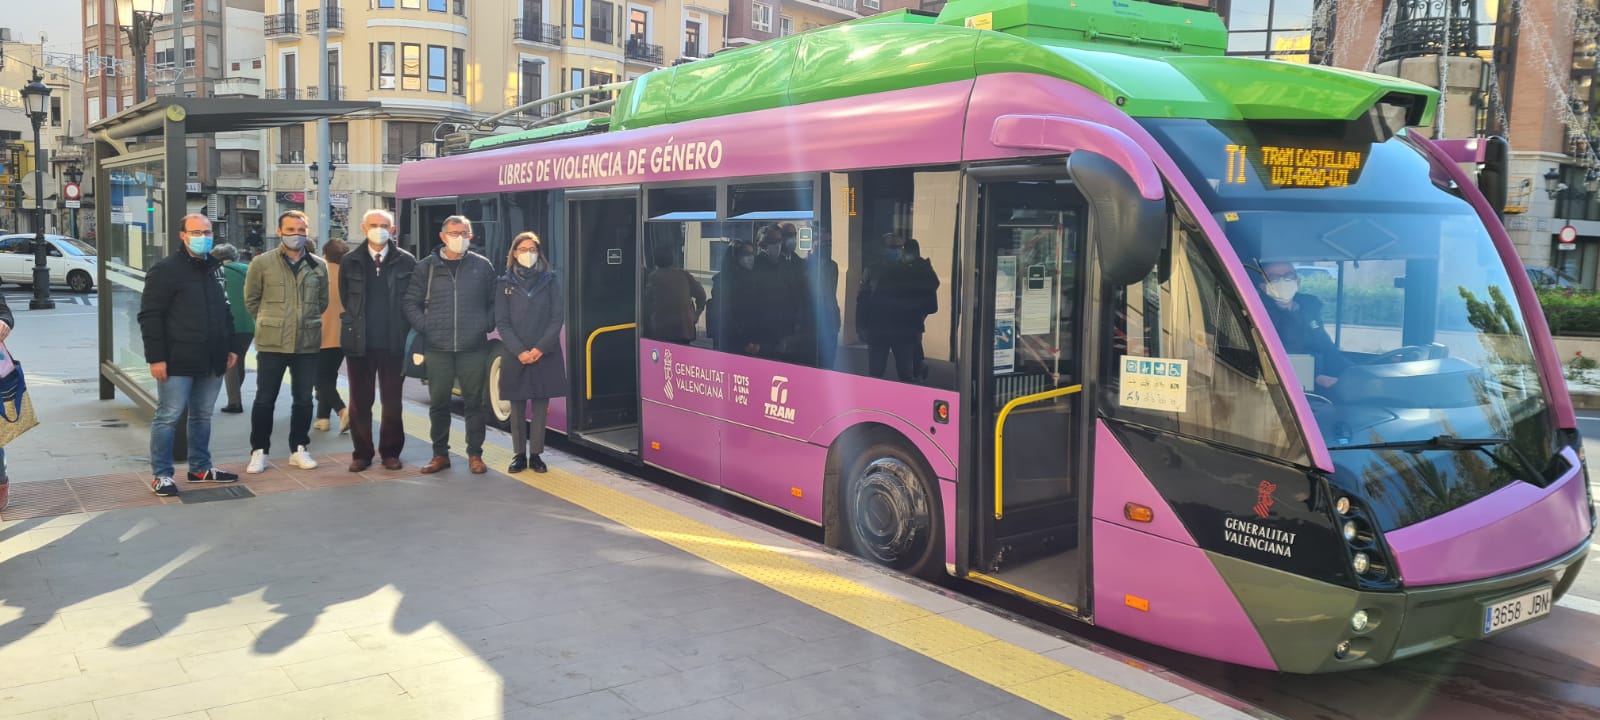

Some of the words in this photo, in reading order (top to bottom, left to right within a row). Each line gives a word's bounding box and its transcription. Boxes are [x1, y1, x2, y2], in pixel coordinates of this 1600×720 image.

[498, 161, 534, 185] LIBRES
[535, 159, 552, 182] DE
[553, 151, 623, 180] VIOLENCIA
[627, 148, 648, 175] DE
[650, 135, 723, 174] GÉNERO
[1225, 144, 1248, 184] T1
[1261, 146, 1295, 166] TRAM
[1295, 148, 1361, 169] CASTELLON
[675, 362, 725, 384] GENERALITAT
[733, 374, 750, 386] TOTS
[676, 378, 724, 400] VALENCIANA
[764, 402, 795, 421] TRAM
[1225, 517, 1296, 545] GENERALITAT
[1224, 530, 1292, 558] VALENCIANA
[1493, 601, 1521, 627] 3658
[1528, 592, 1549, 615] JBN
